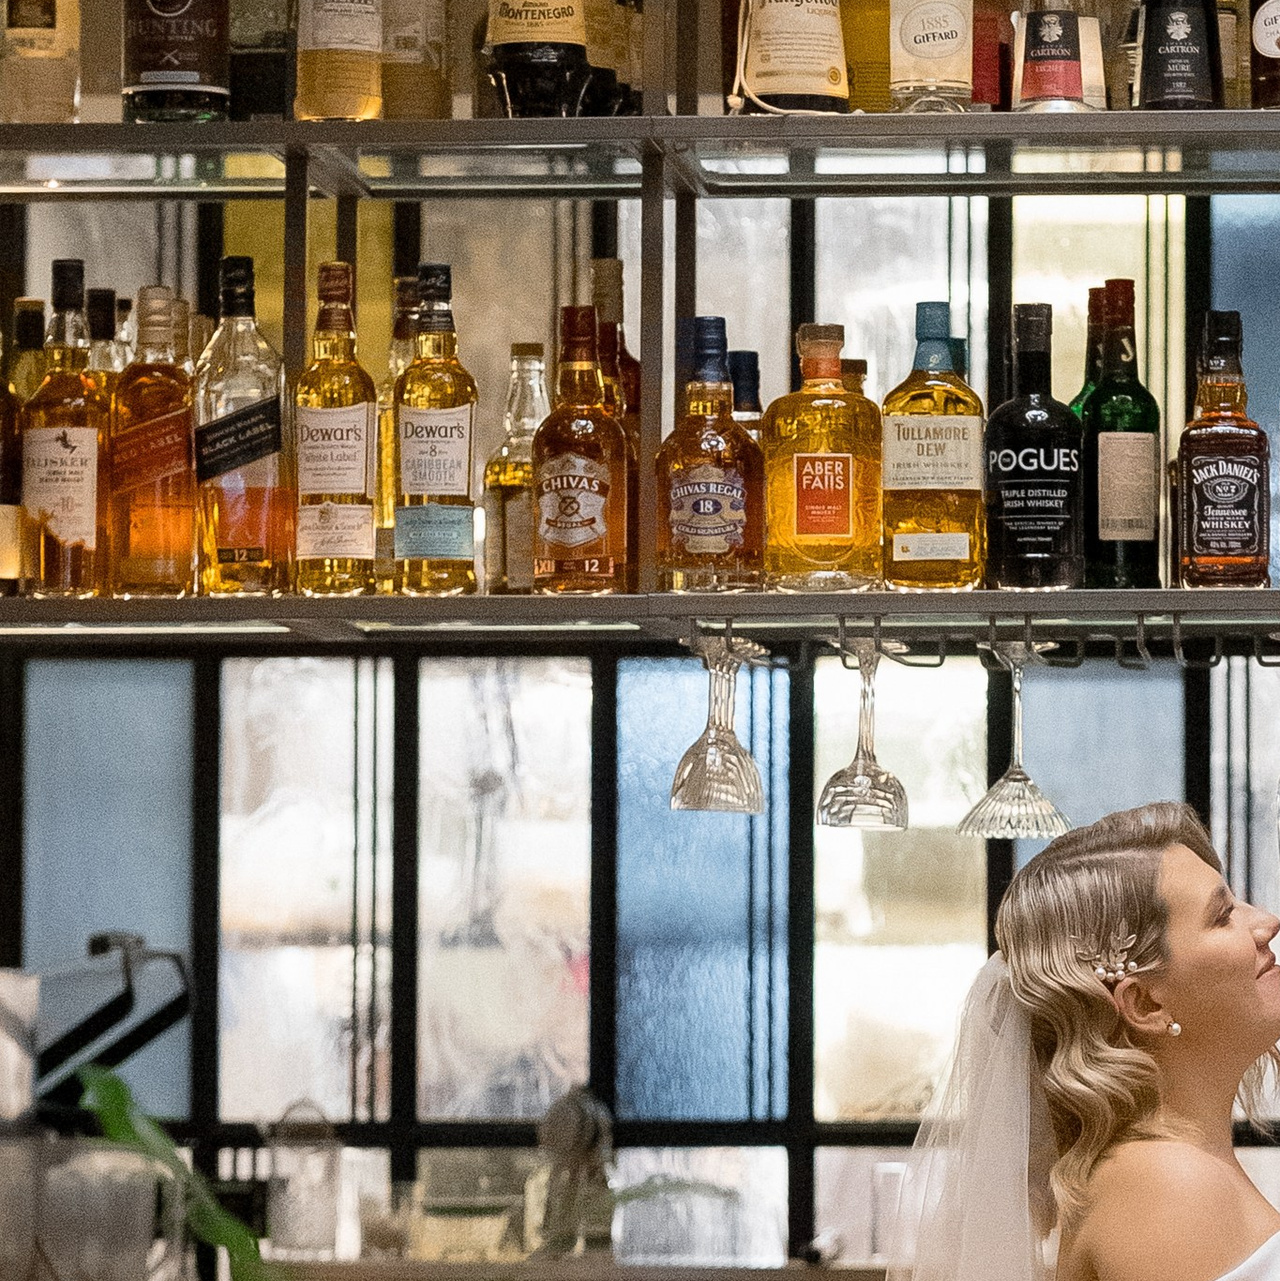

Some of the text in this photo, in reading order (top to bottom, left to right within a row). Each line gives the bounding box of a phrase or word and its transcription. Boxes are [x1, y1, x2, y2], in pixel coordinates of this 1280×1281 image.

[499, 1, 575, 20] MONTENEGRO
[913, 29, 958, 45] GIFFARD
[1030, 48, 1071, 57] CARTRON
[1158, 45, 1200, 55] CARTRON
[300, 423, 363, 442] Dewar's
[404, 421, 464, 439] Dewar's
[894, 422, 970, 441] TULLAMORE
[202, 435, 237, 456] BLACK
[238, 423, 277, 441] LABEL
[429, 444, 437, 458] 8
[916, 442, 947, 457] DEW
[404, 458, 462, 470] CARIBBEAN
[892, 461, 970, 469] IRISH WHISKEY
[989, 448, 1079, 472] POGUES
[802, 461, 844, 475] ABER
[1192, 460, 1260, 485] JACK DANIEL'S
[412, 470, 456, 482] SMOOTH
[542, 475, 600, 492] CHIVAS
[671, 482, 743, 500] CHIVAS REGAL
[1001, 489, 1068, 498] TRIPLE DISTILLED
[699, 500, 713, 513] 18
[1003, 500, 1064, 509] IRISH WHISKEY
[1203, 505, 1248, 517] Tennessee
[677, 524, 736, 535] GOLD SIGNATURE
[1201, 521, 1251, 529] WHISKEY
[233, 548, 249, 562] 12
[584, 559, 599, 572] 12
